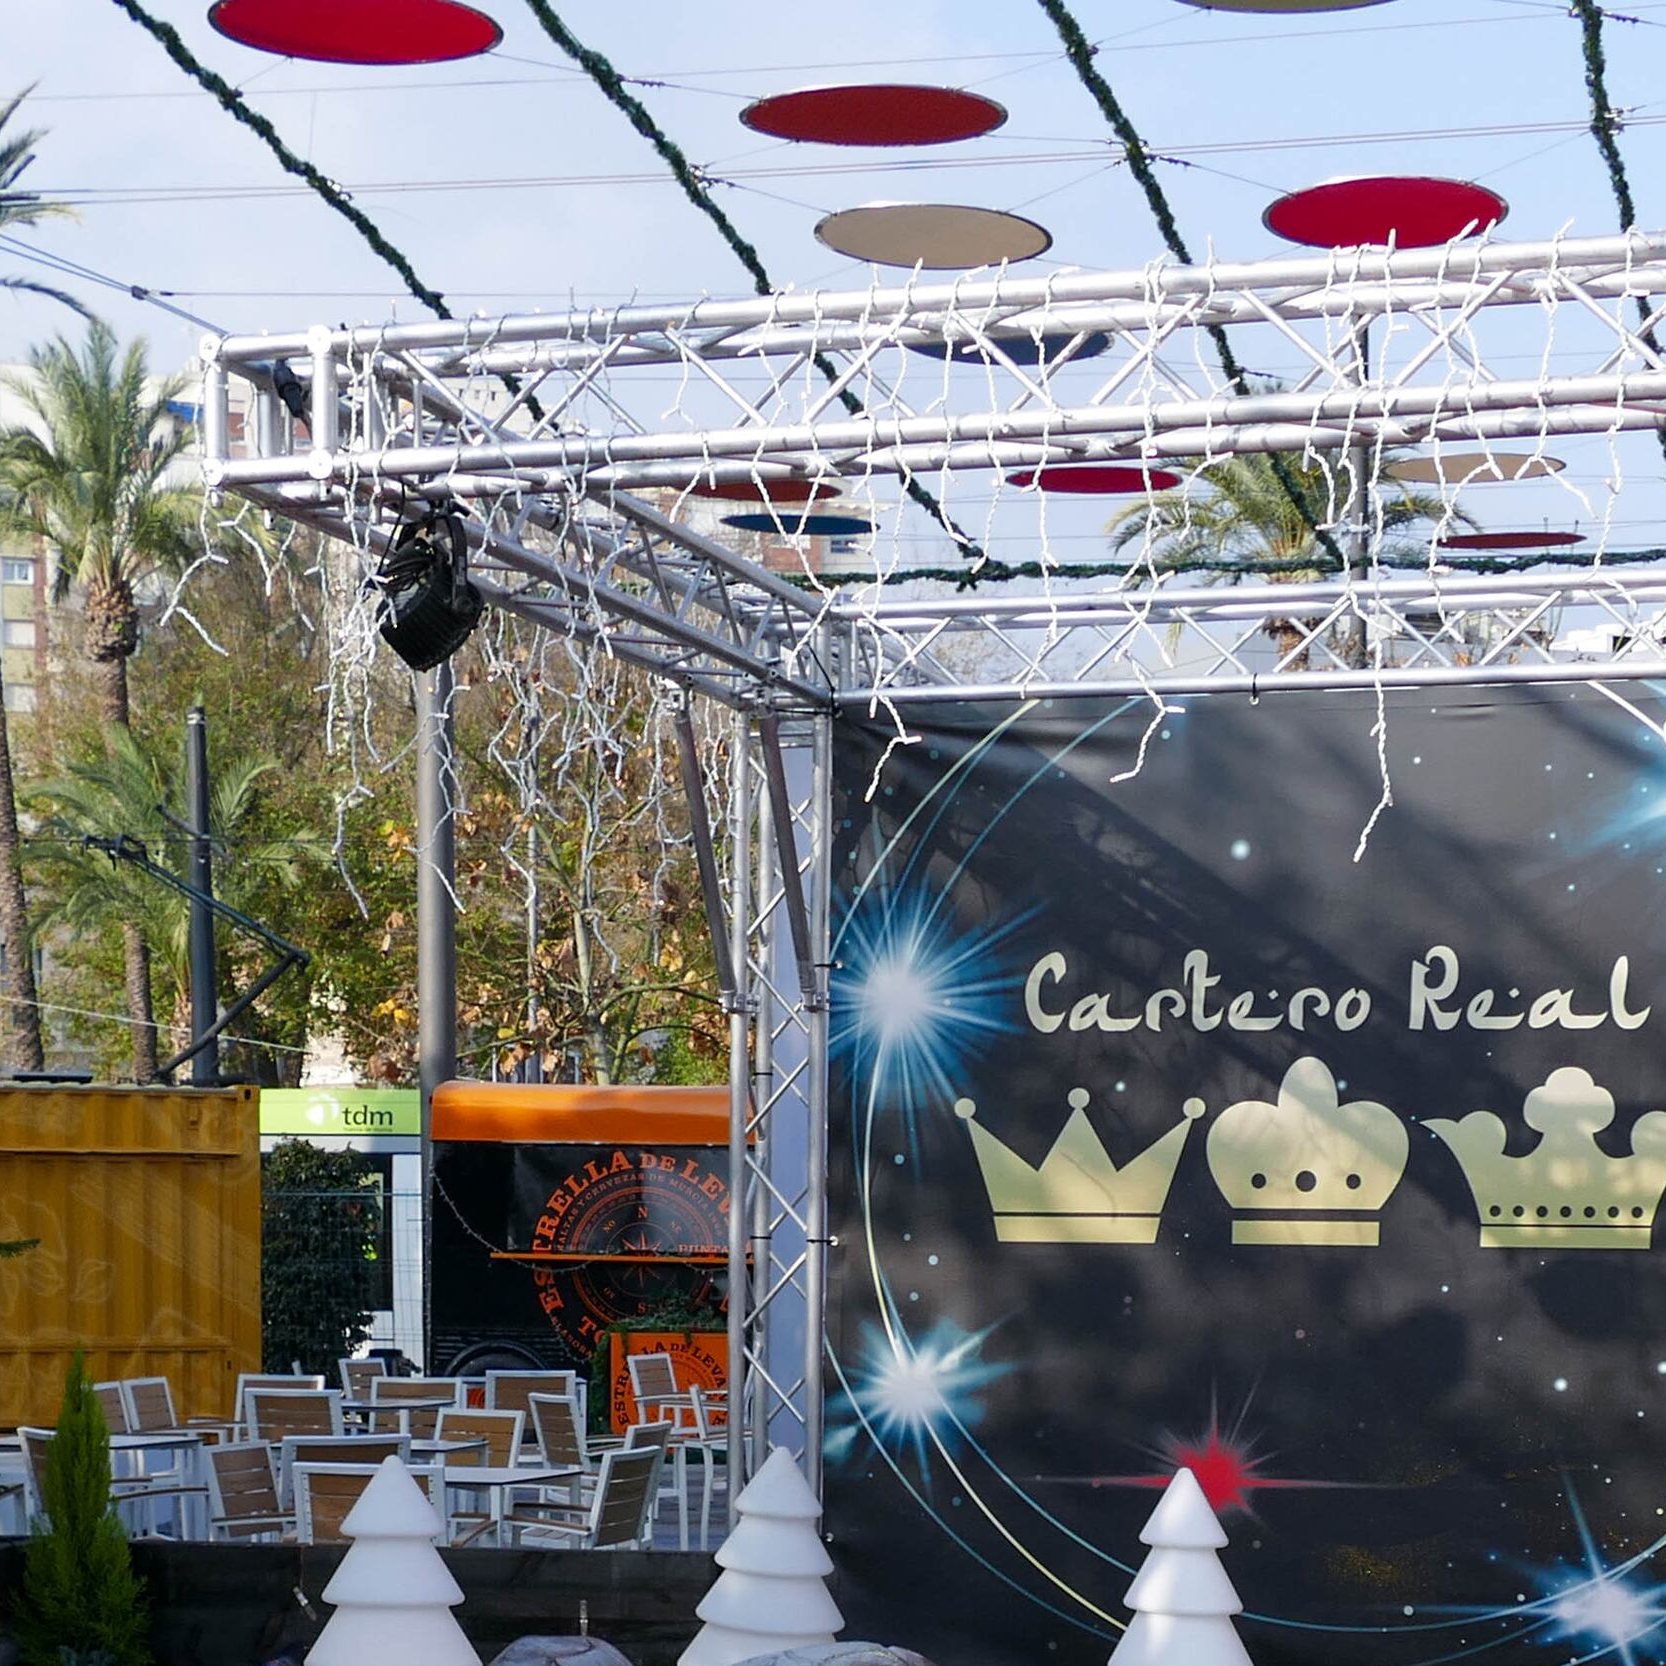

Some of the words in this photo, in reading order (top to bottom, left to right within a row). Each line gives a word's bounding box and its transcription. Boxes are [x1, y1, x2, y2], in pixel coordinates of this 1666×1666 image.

[1025, 949, 1371, 1032] Cartero
[1409, 945, 1651, 1030] Real
[342, 1105, 393, 1125] tdm
[639, 1153, 676, 1172] DE
[637, 1206, 648, 1218] N
